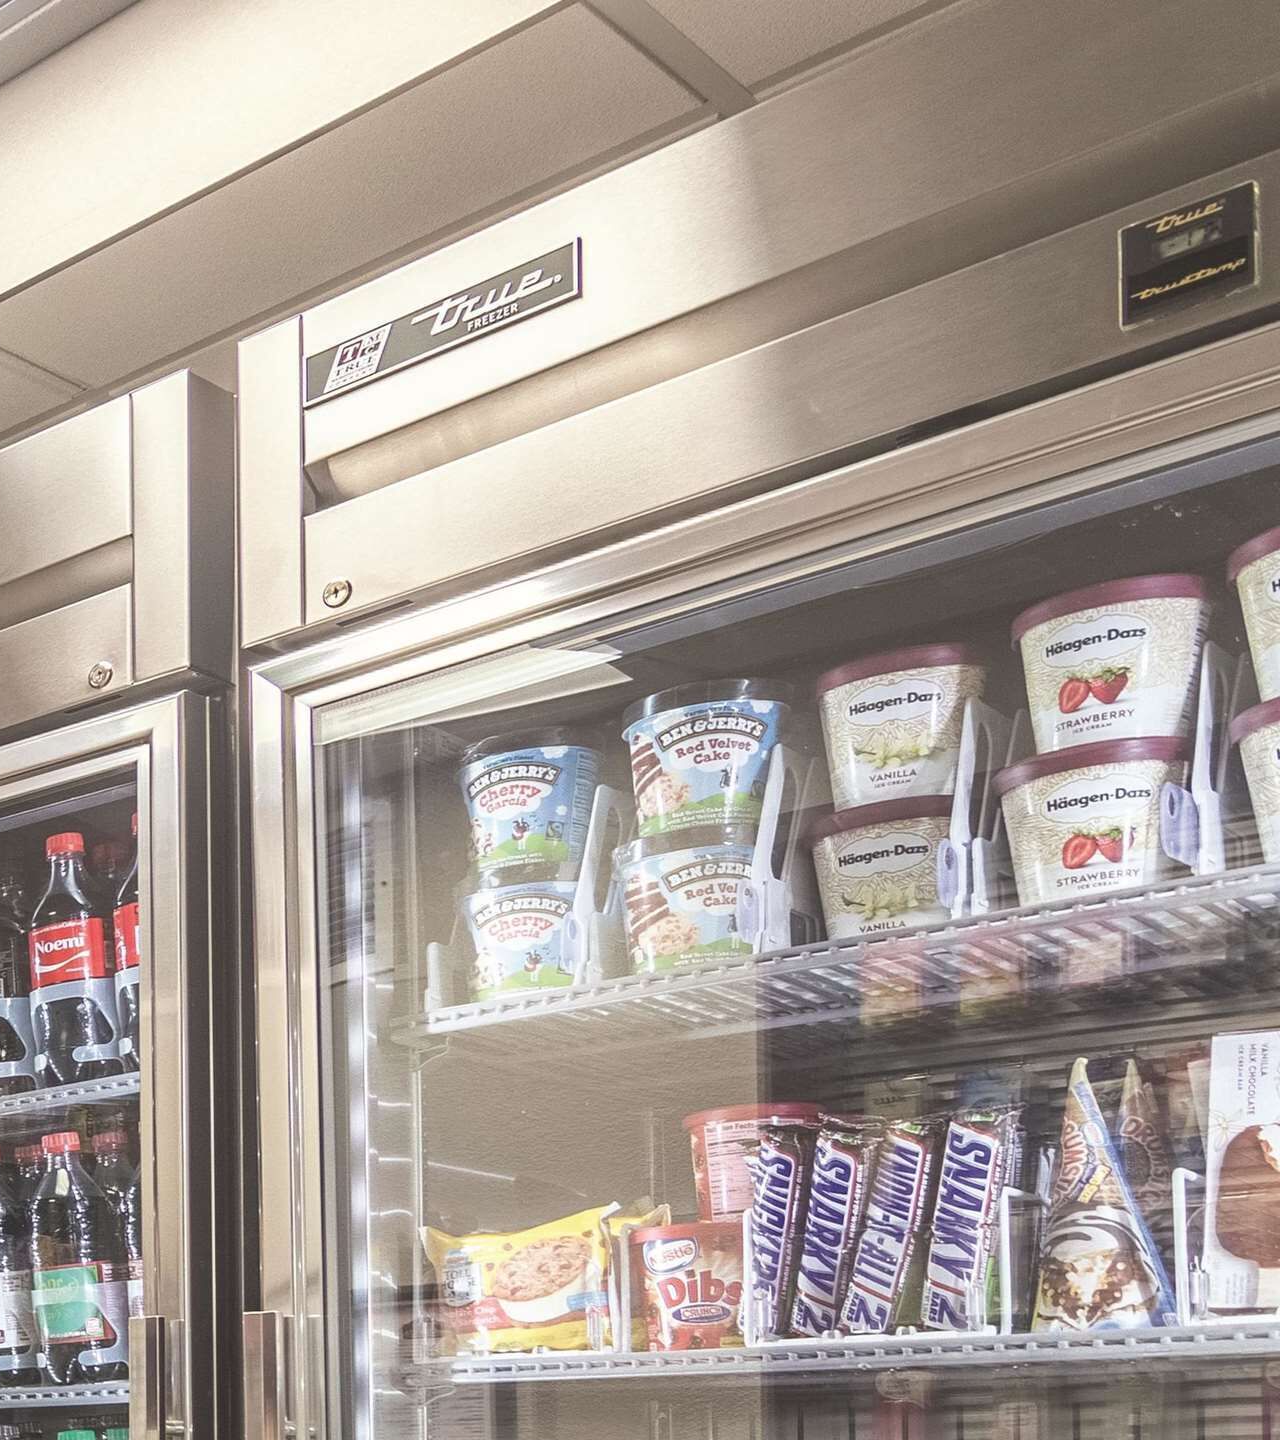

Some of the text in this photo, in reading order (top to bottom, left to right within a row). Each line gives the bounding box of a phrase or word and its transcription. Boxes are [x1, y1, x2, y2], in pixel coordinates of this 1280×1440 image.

[467, 303, 518, 332] FREEZER
[1045, 626, 1147, 658] Häagen-Dazs
[1055, 708, 1135, 732] STRAWBERRY
[659, 726, 692, 748] BEN
[675, 738, 751, 759] Red Velvet
[693, 750, 731, 765] Cake
[869, 768, 917, 783] VANILLA
[479, 783, 541, 808] Cherry
[486, 796, 529, 814] Garcia
[1047, 786, 1152, 813] Häagen-Dazs
[1056, 868, 1140, 888] STRAWBERRY
[800, 1147, 854, 1297] SNARKY
[681, 1307, 723, 1321] CRUNCH
